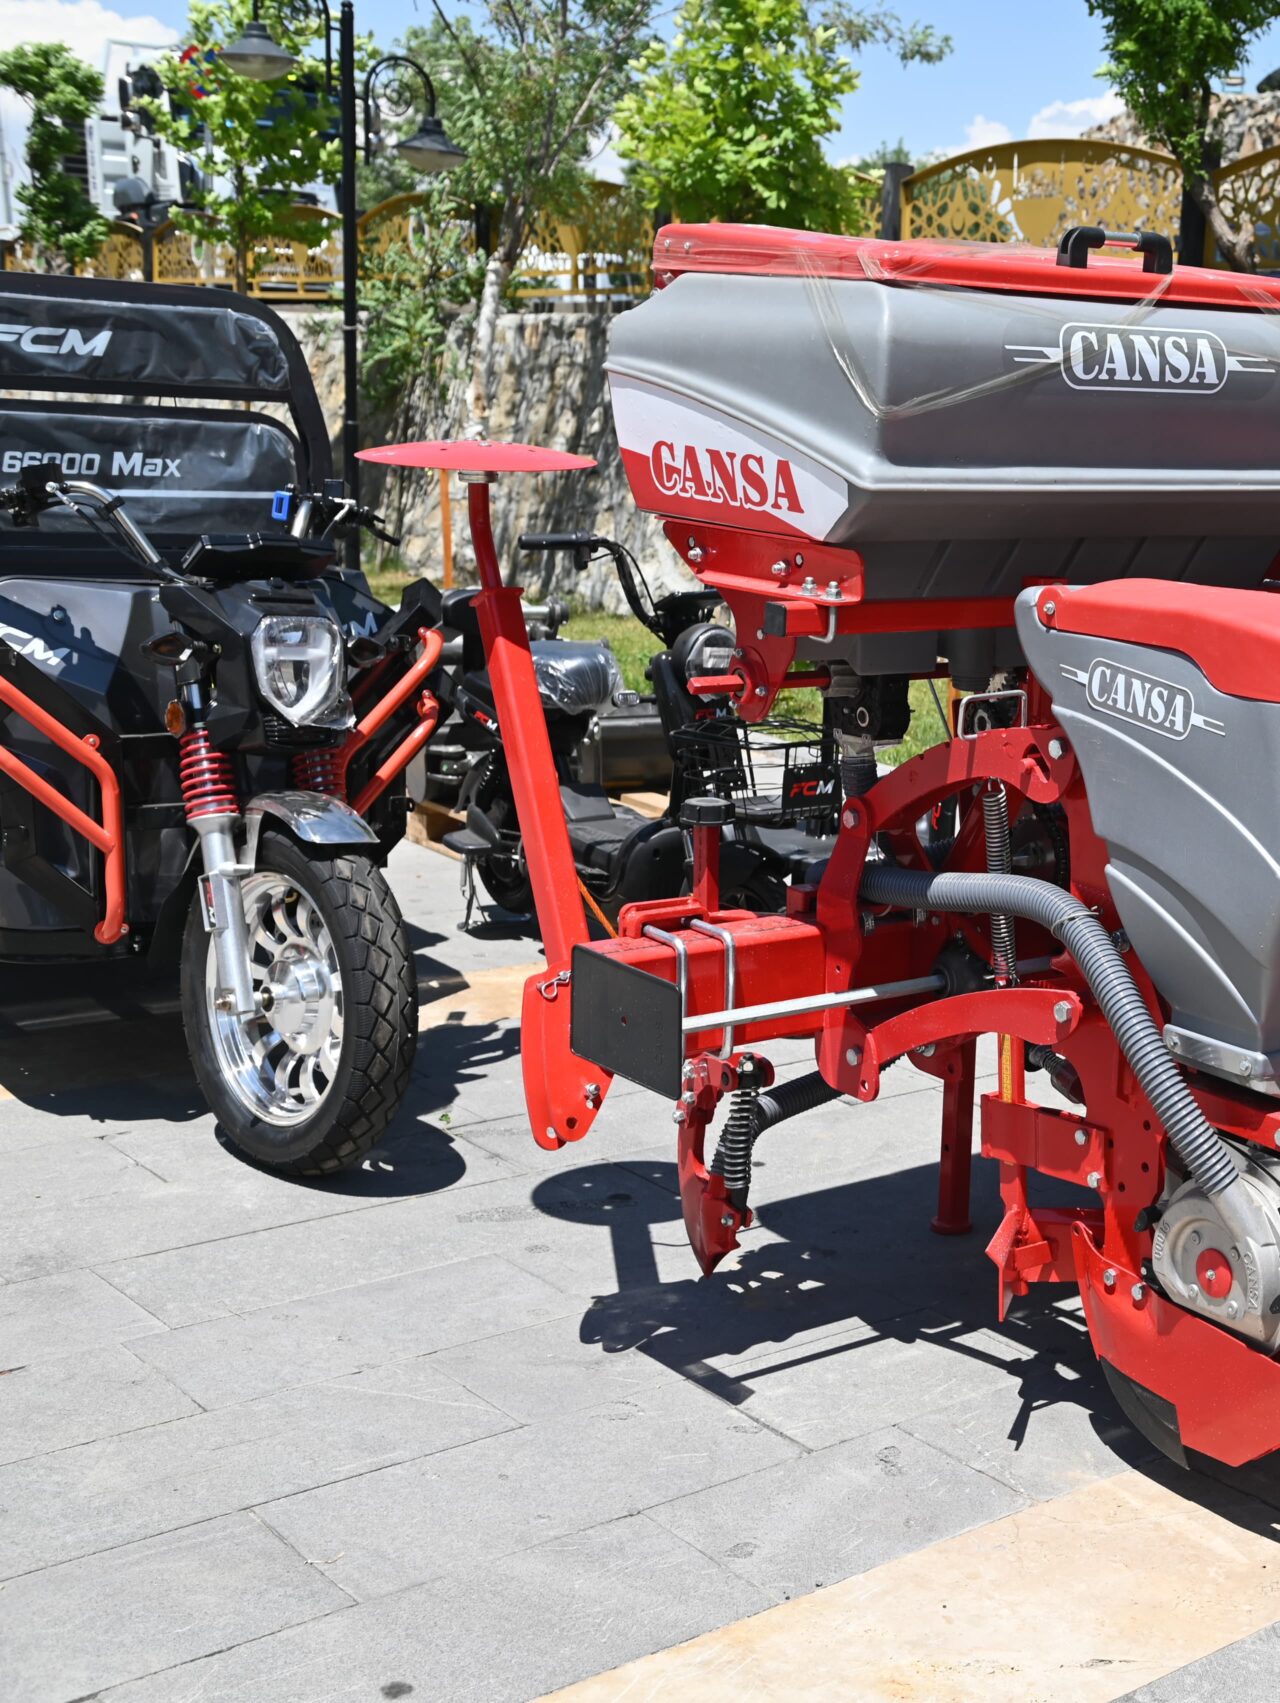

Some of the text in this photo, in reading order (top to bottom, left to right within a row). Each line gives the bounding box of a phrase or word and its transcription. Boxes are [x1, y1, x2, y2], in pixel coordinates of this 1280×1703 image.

[1070, 331, 1219, 384] CANSA
[111, 452, 182, 478] Max
[651, 440, 805, 514] CANSA
[1091, 666, 1185, 733] CANSA
[789, 780, 835, 798] FCM
[1242, 1252, 1260, 1311] CANSA
